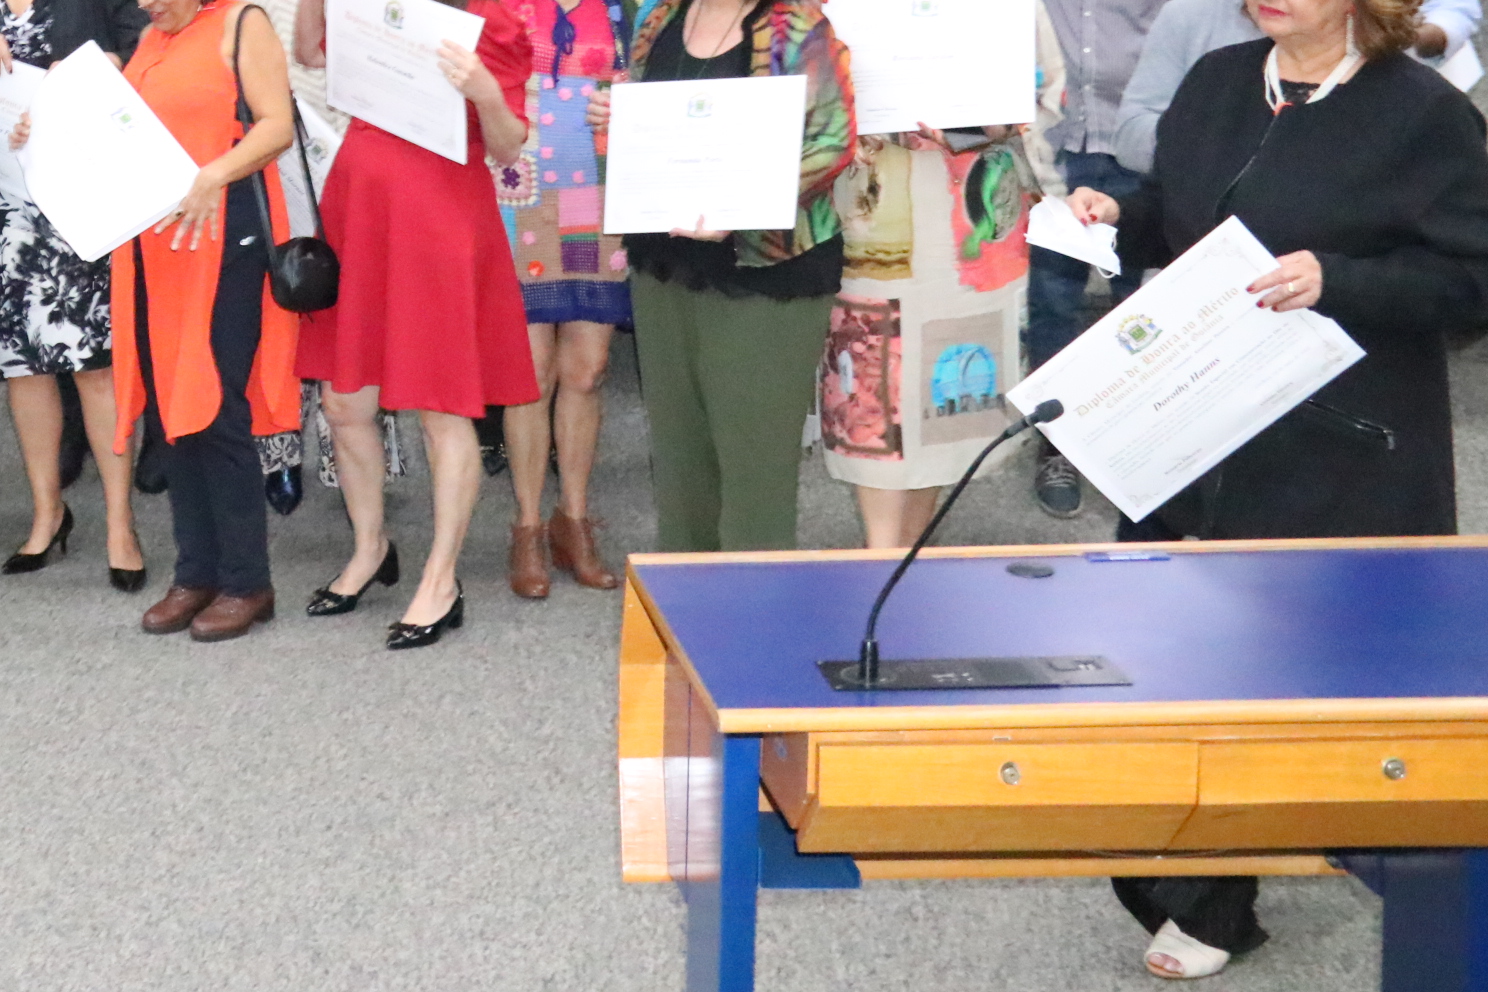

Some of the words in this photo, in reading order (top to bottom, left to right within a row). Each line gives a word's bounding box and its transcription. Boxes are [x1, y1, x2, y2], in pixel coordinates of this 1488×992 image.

[1074, 377, 1126, 417] Diploma
[1124, 365, 1140, 378] de
[1142, 334, 1181, 365] Honra
[1182, 320, 1197, 334] ao
[1152, 381, 1190, 412] Dorothy
